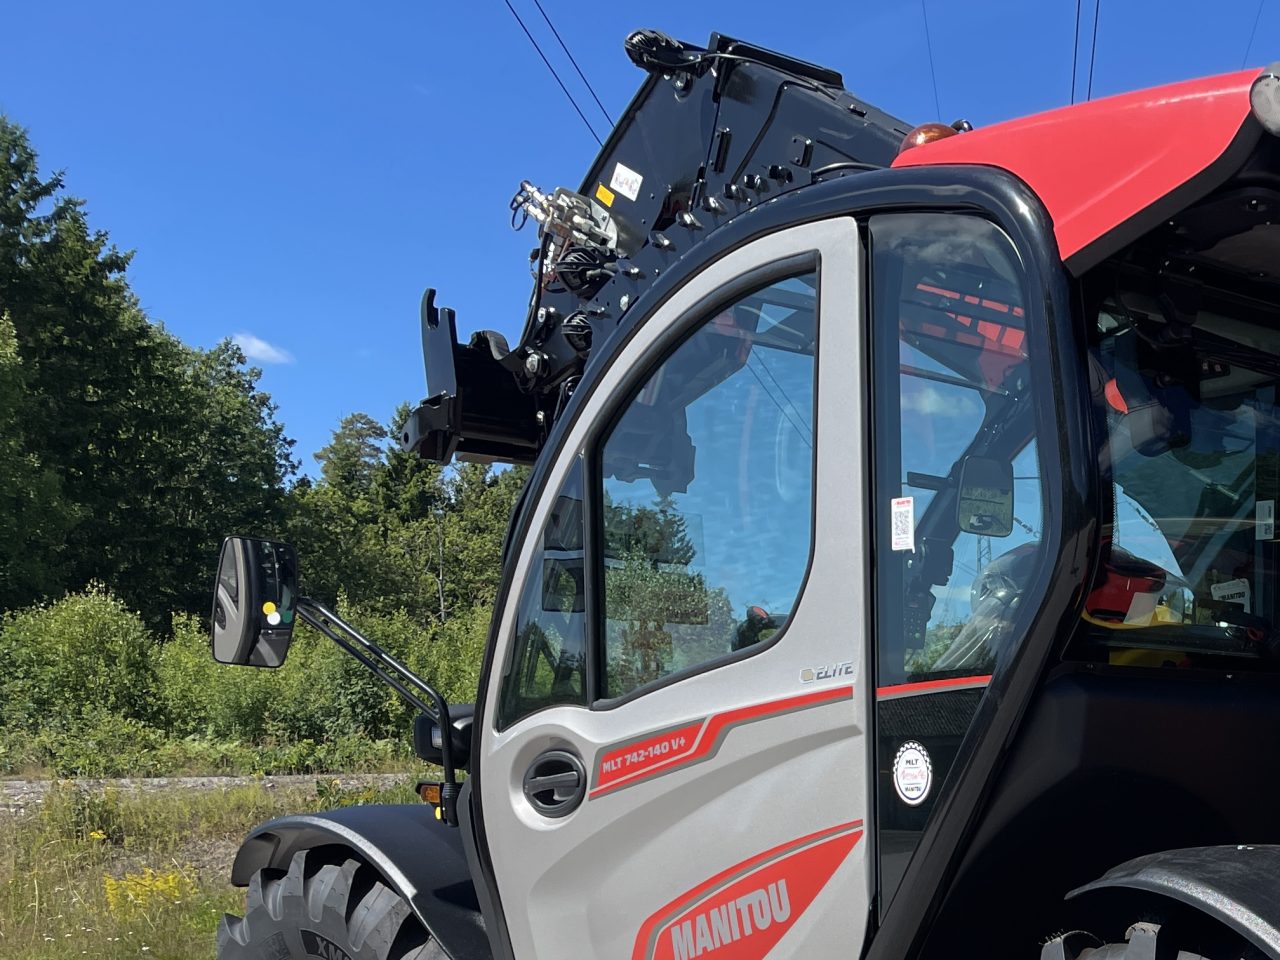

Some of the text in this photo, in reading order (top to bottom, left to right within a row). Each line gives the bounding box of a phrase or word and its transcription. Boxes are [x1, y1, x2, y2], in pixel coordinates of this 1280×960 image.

[816, 661, 853, 680] ELITE
[602, 736, 686, 774] MLT 742-140 V+
[905, 758, 919, 766] MLT
